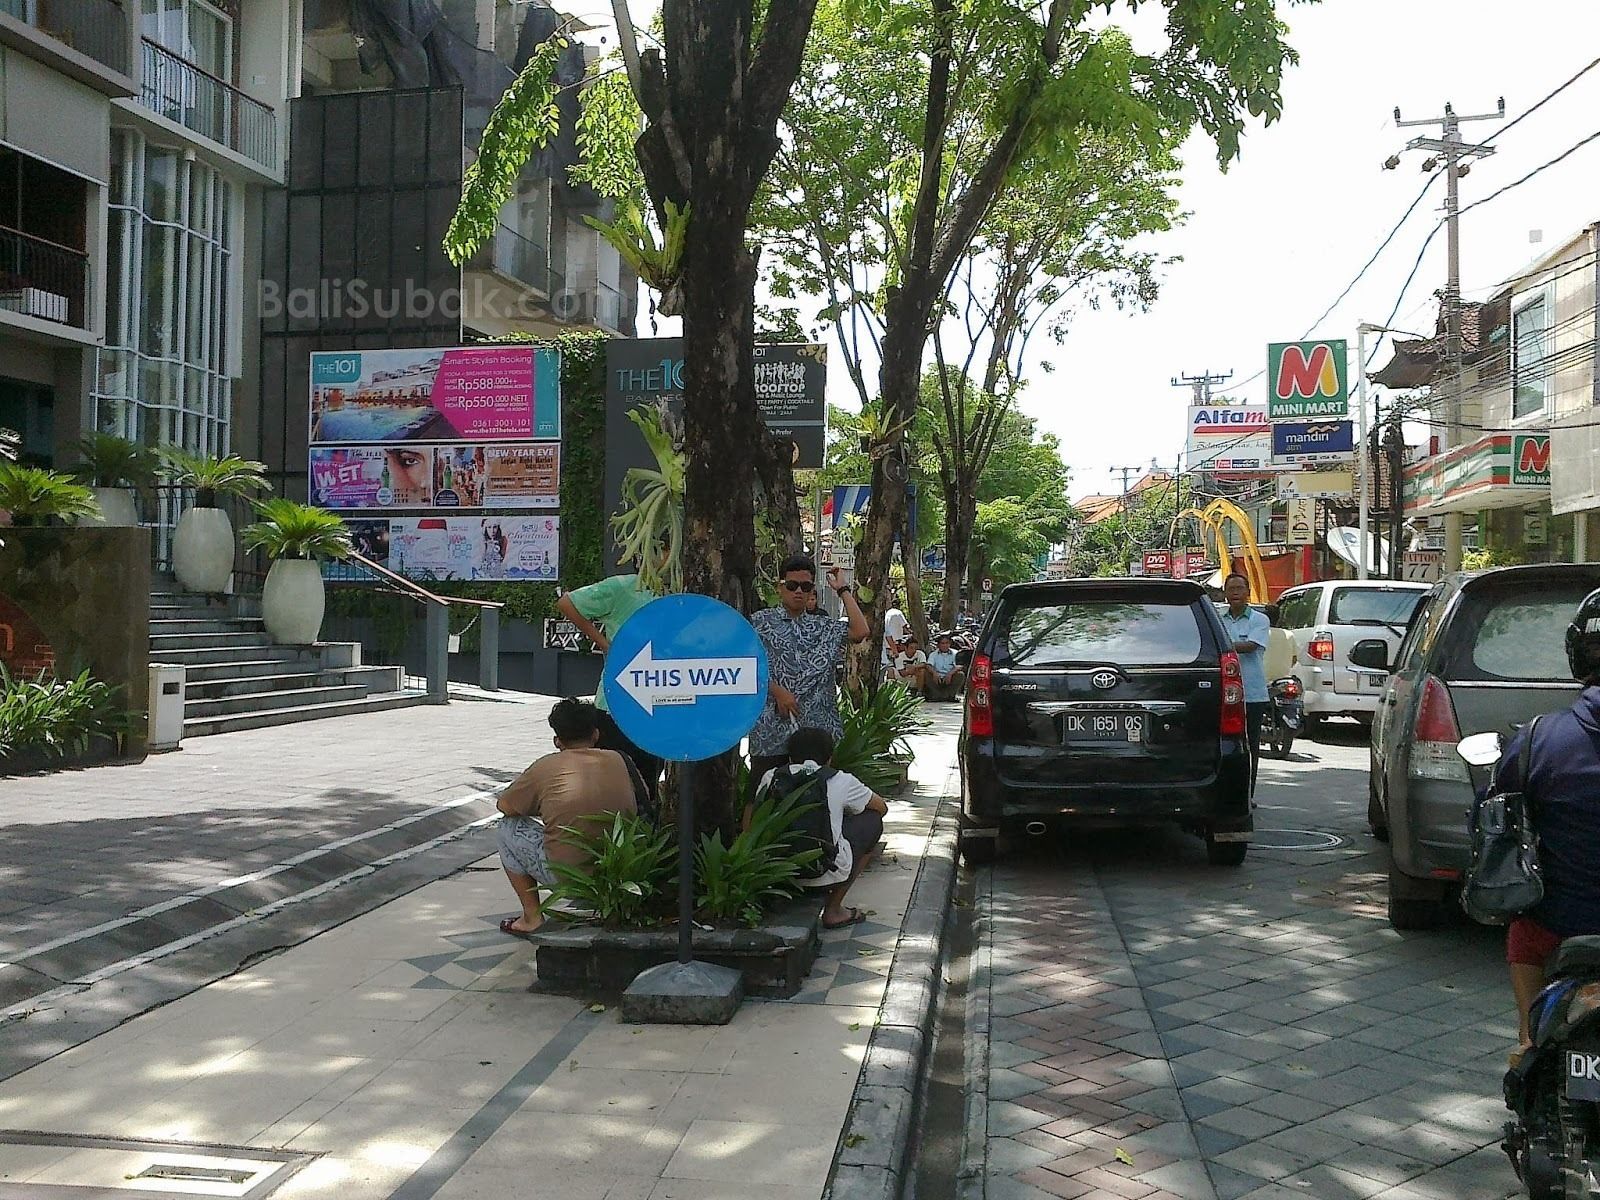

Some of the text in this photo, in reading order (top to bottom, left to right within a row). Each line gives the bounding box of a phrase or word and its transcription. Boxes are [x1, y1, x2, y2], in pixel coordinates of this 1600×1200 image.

[444, 356, 532, 367] Smart Stylish Booking
[1272, 401, 1344, 415] MINI MART
[1194, 410, 1269, 424] Alfam
[1286, 432, 1329, 443] mandiri
[512, 448, 535, 457] YEAR
[537, 448, 554, 456] EVE
[317, 464, 361, 487] WET
[1515, 475, 1536, 483] MINI
[1146, 555, 1166, 564] DVD
[1403, 553, 1438, 562] TATTOO
[1409, 563, 1431, 578] 77
[630, 667, 742, 687] THIS WAY
[1068, 715, 1086, 731] DK
[1092, 715, 1118, 731] 1651
[1571, 1053, 1600, 1081] DK
